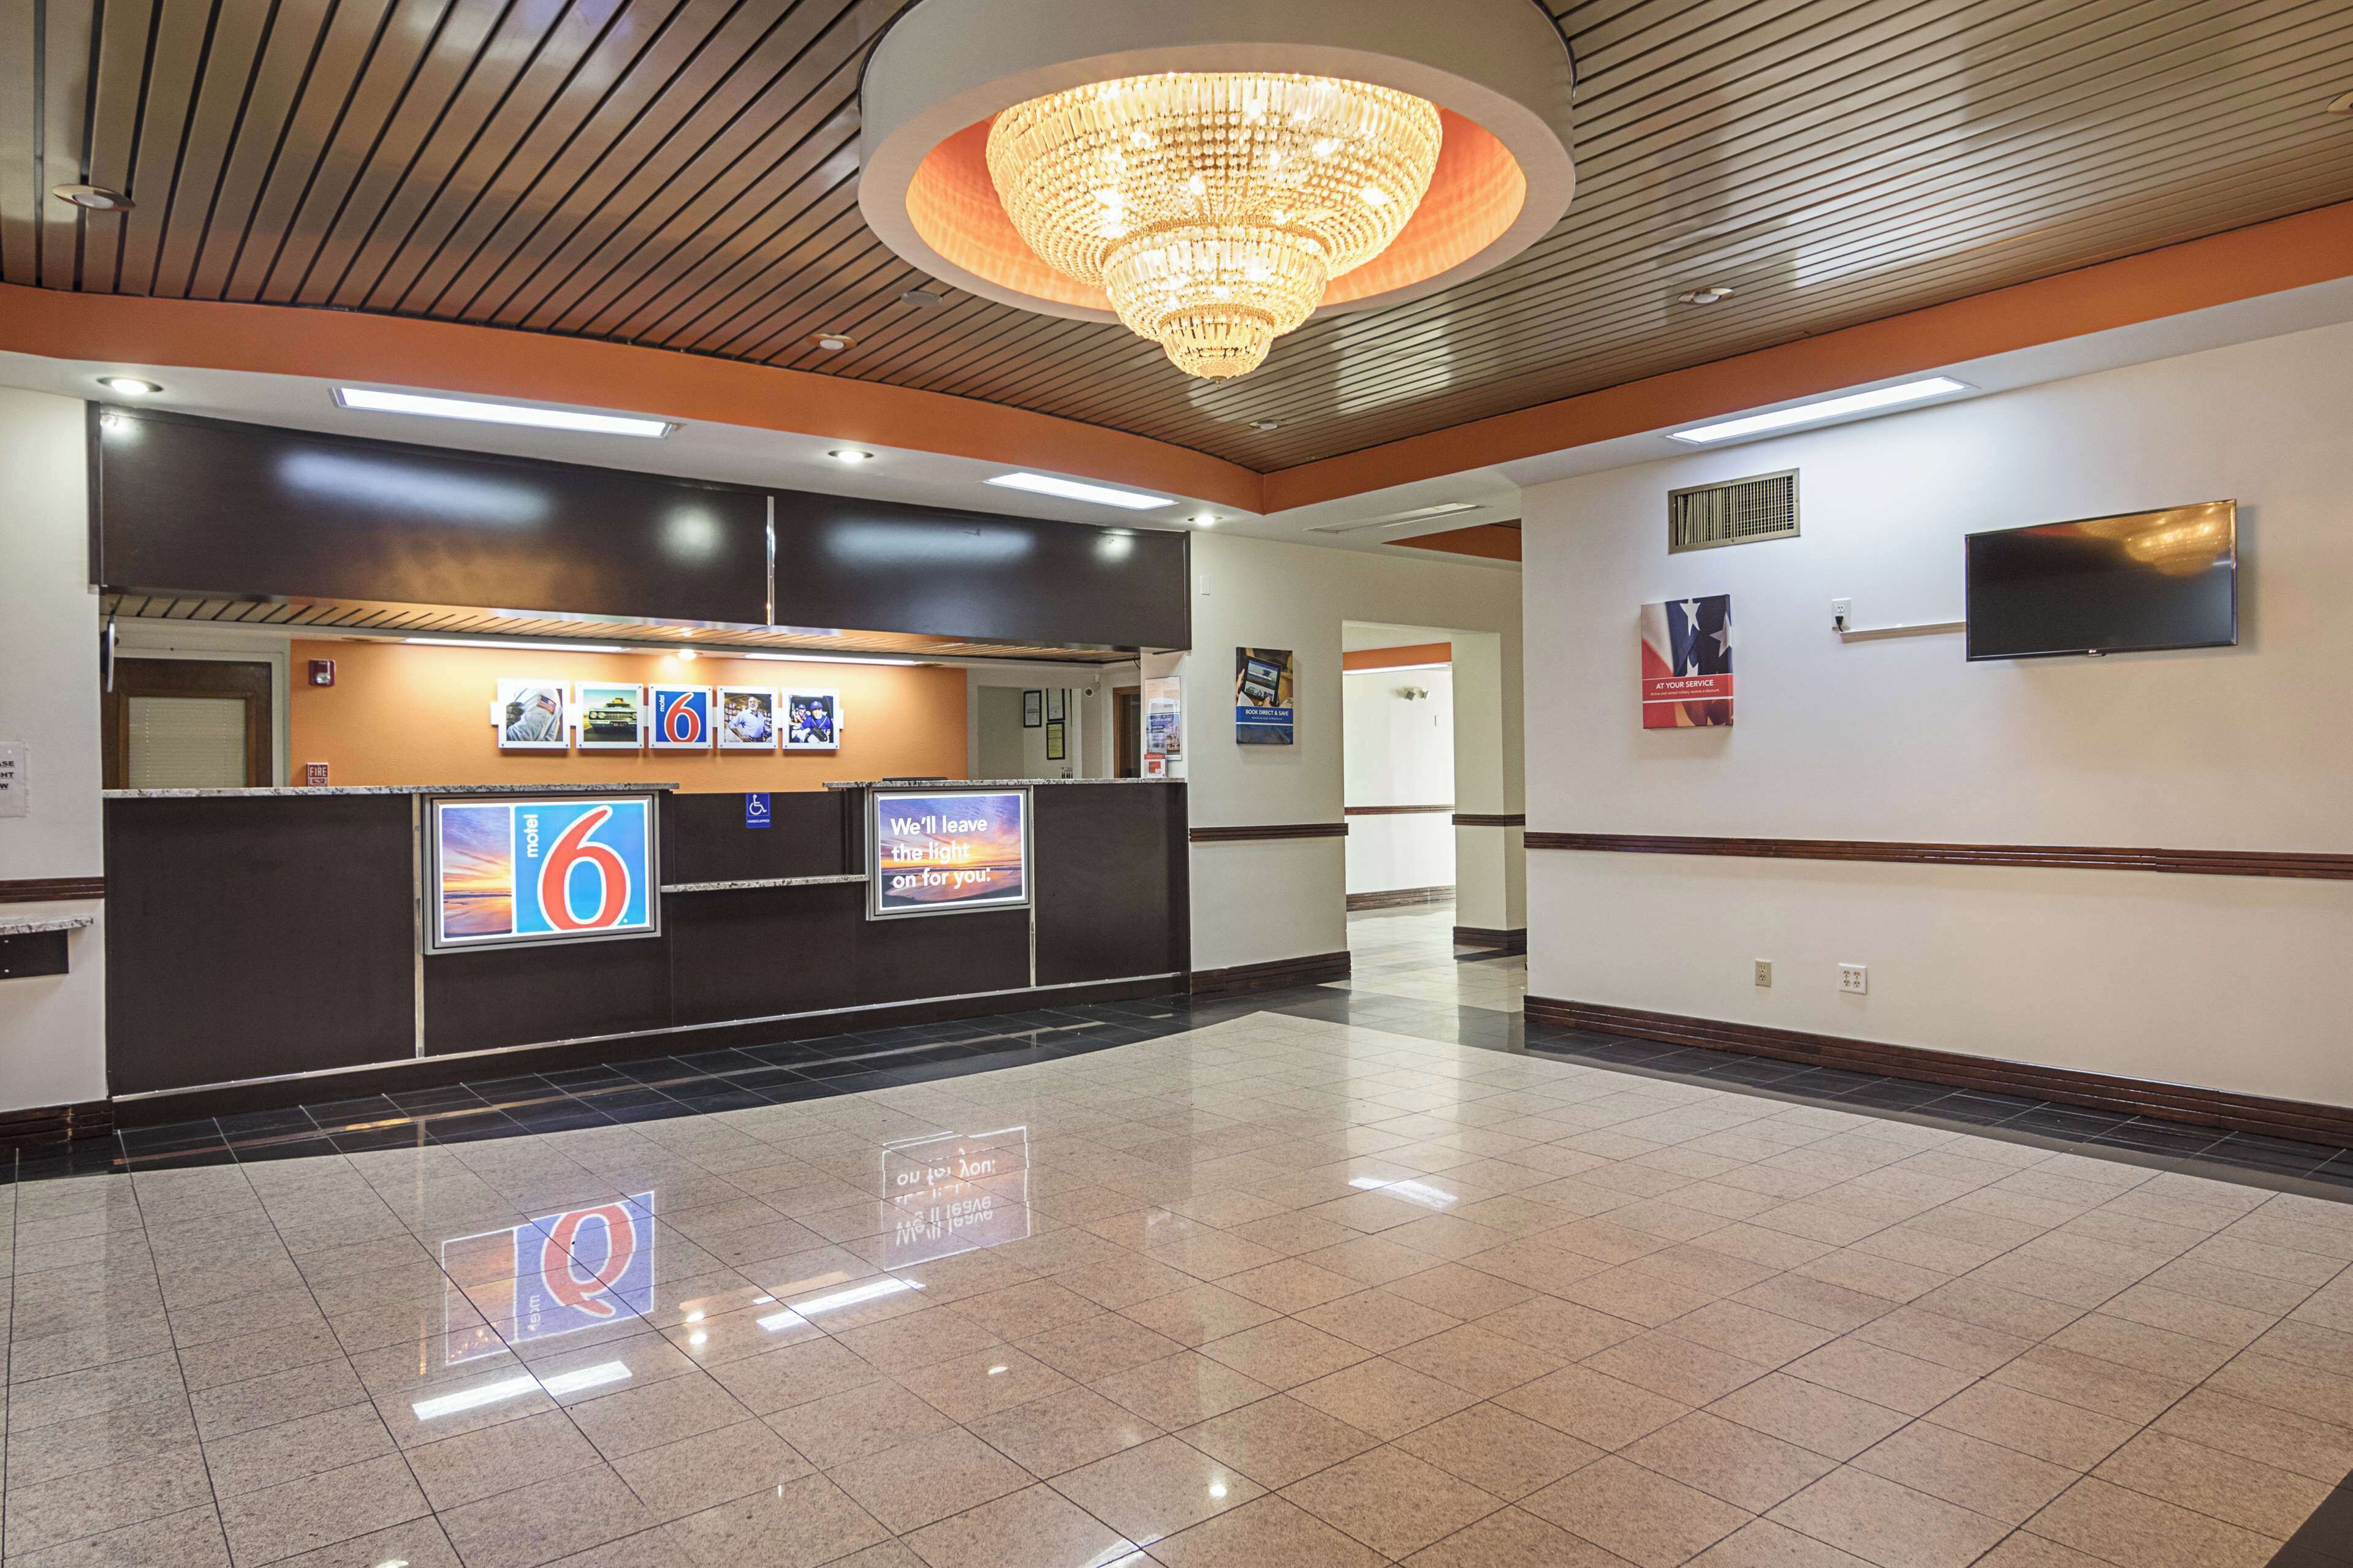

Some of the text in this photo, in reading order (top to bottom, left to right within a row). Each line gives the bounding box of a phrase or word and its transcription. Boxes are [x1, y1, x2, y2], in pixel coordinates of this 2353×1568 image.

[664, 692, 701, 743] 6
[310, 767, 327, 776] FIRE
[891, 815, 988, 836] We'll leave
[891, 840, 970, 864] the light
[523, 805, 631, 931] motel 6
[892, 874, 916, 888] on
[922, 867, 949, 887] for
